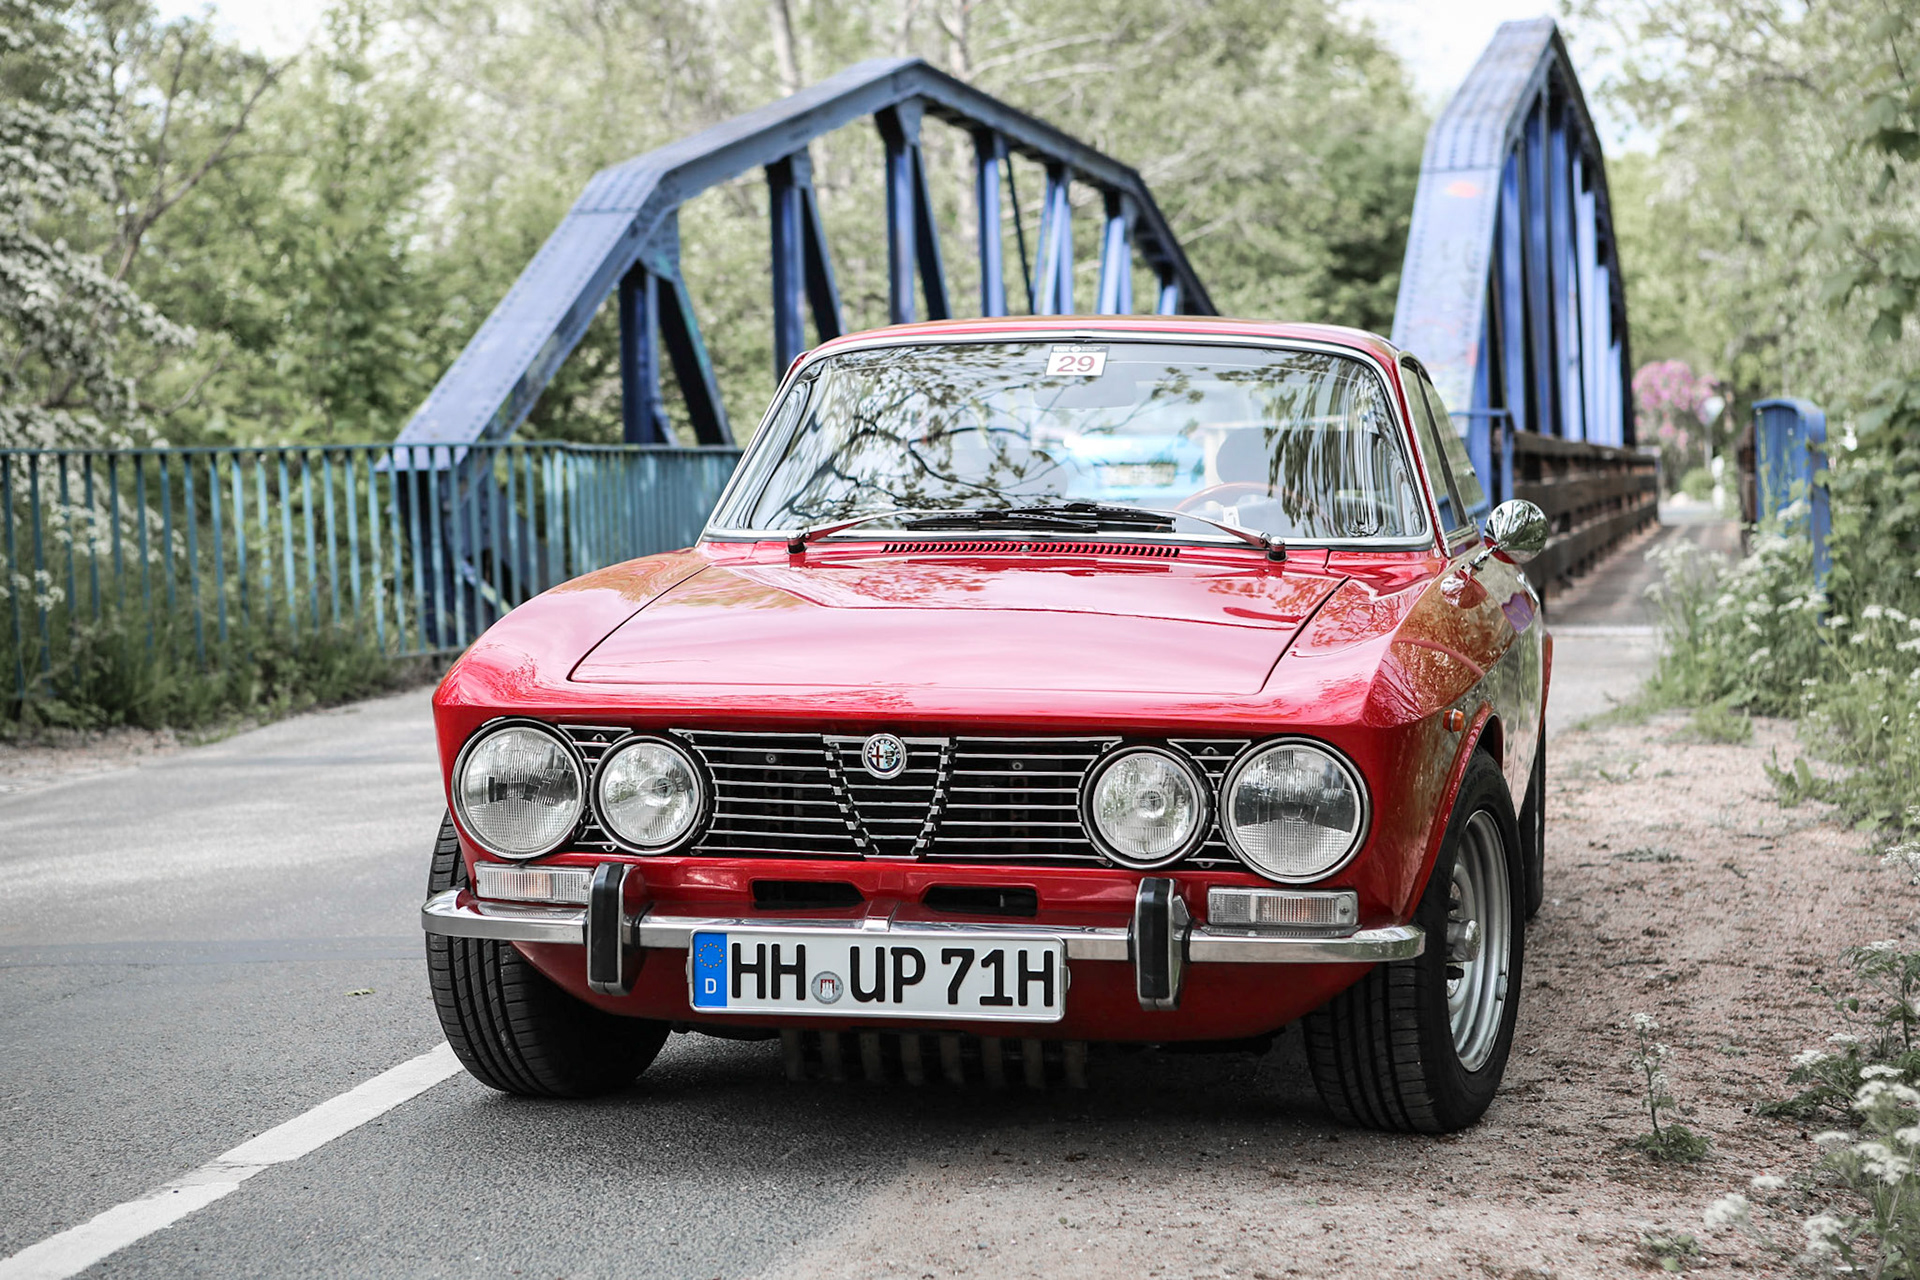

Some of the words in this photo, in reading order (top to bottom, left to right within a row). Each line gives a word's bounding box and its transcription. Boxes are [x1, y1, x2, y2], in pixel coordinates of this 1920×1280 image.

[1056, 355, 1095, 372] 29
[731, 942, 806, 1001] HH
[849, 945, 926, 1003] UP
[941, 948, 1054, 1007] 71H
[705, 978, 717, 993] D
